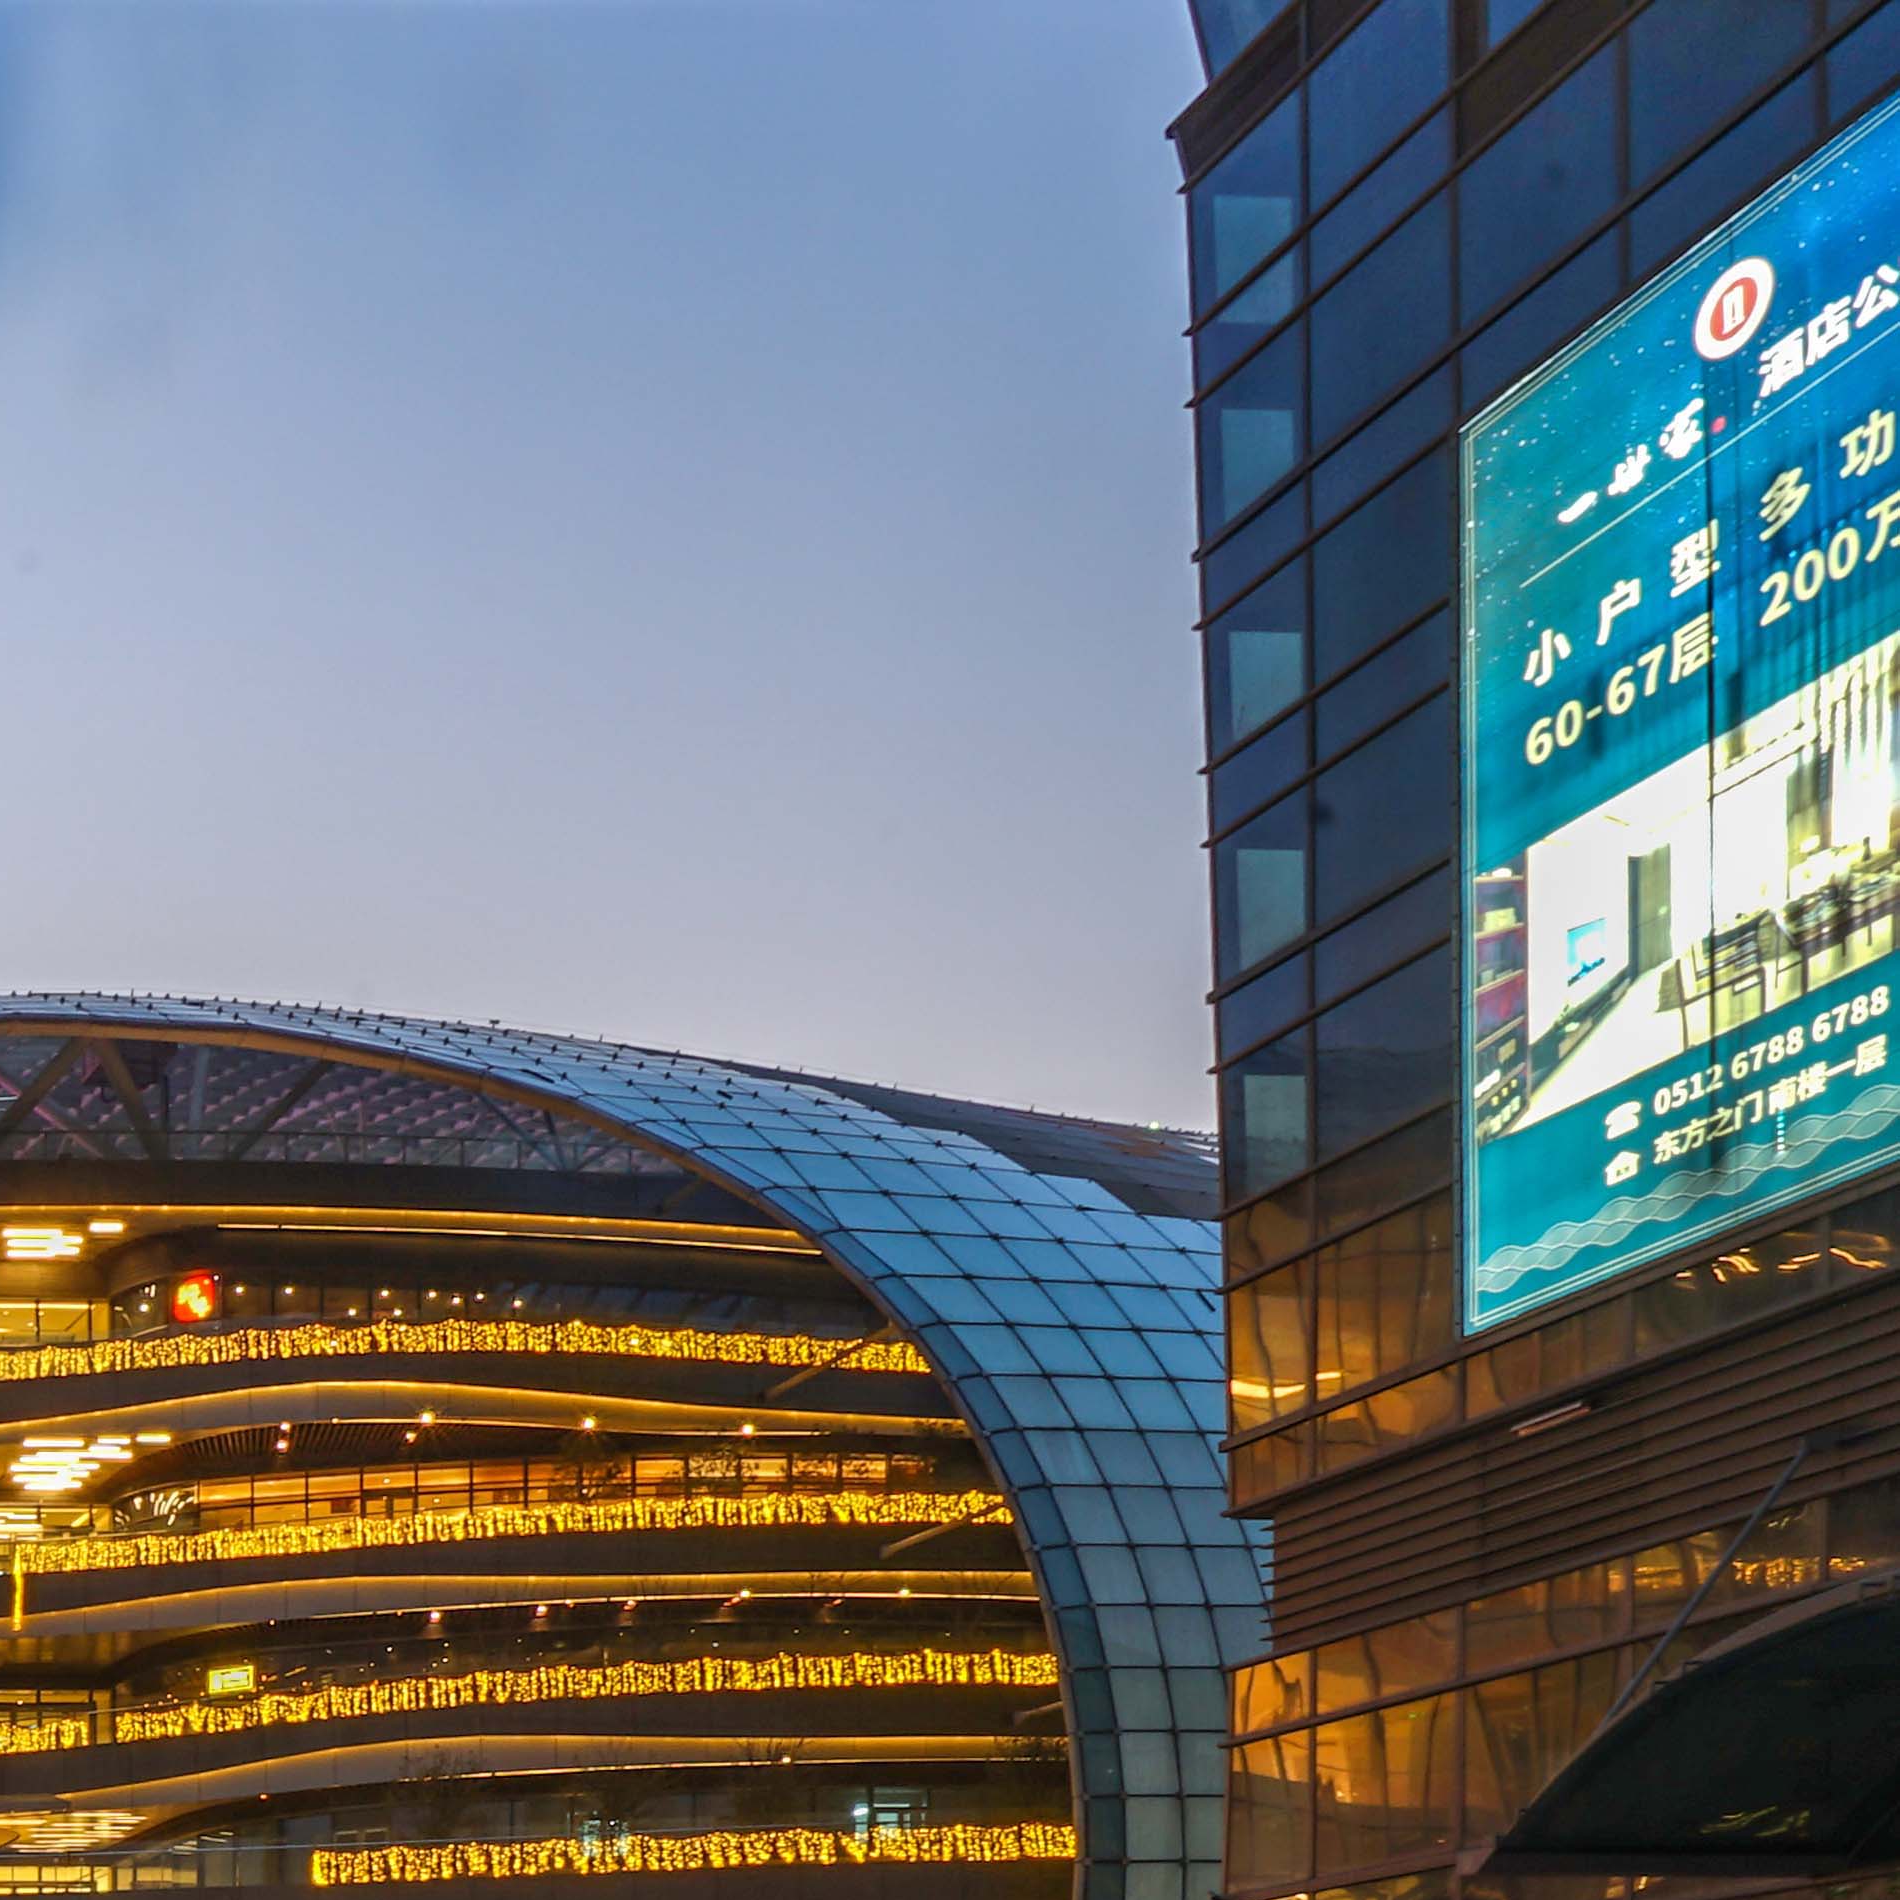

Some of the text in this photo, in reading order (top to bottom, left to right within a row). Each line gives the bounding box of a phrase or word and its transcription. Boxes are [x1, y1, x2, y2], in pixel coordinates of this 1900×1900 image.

[1526, 611, 1718, 766] 60-67层
[1654, 985, 1889, 1115] 0512 6788 6788
